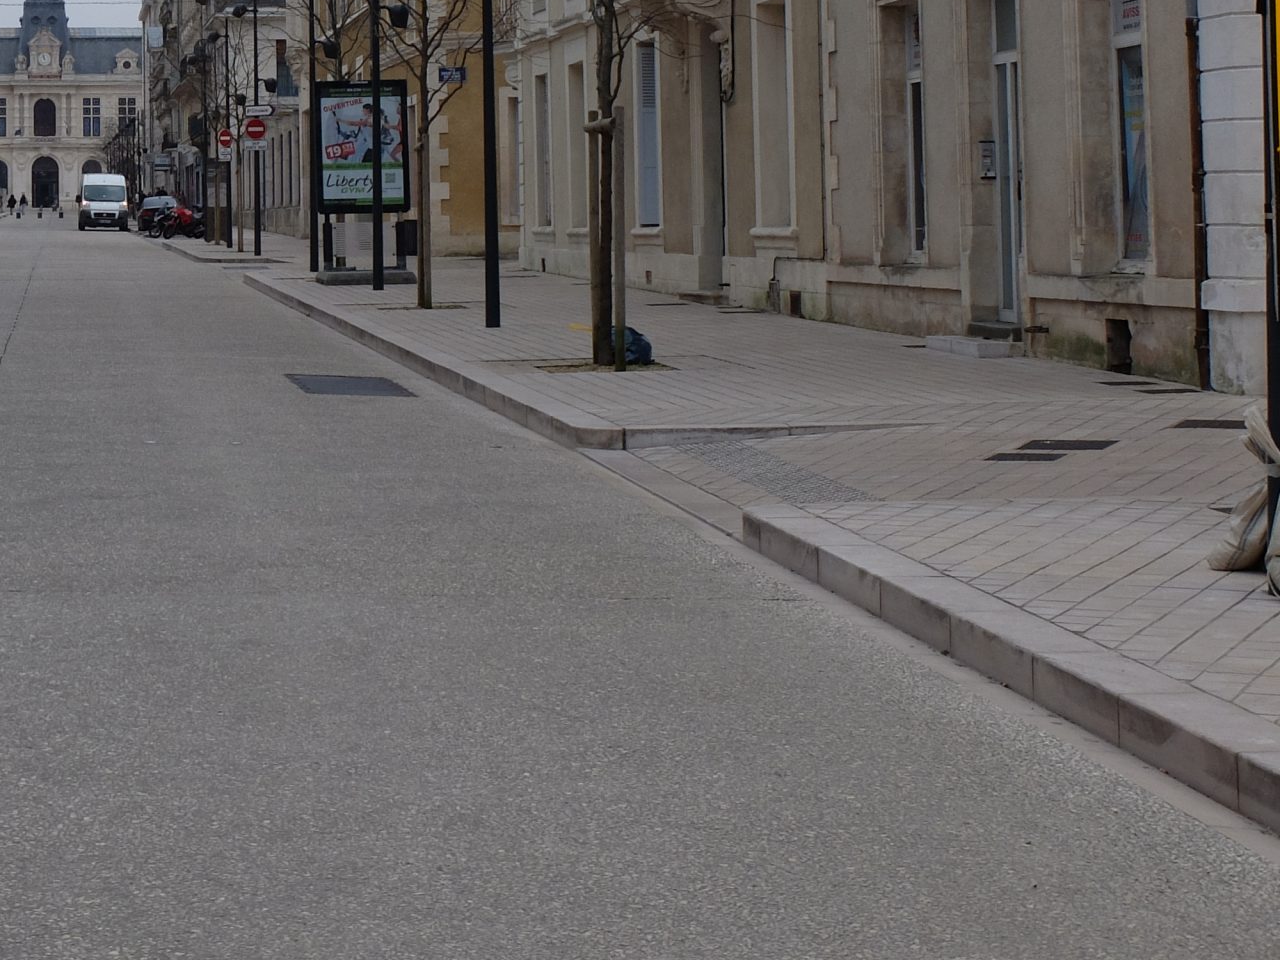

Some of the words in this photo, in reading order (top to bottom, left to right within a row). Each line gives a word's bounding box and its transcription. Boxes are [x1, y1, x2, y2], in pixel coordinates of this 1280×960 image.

[323, 97, 364, 113] OUVERTURE
[326, 145, 341, 158] 19
[326, 173, 373, 193] Liberty
[340, 186, 365, 194] GYM
